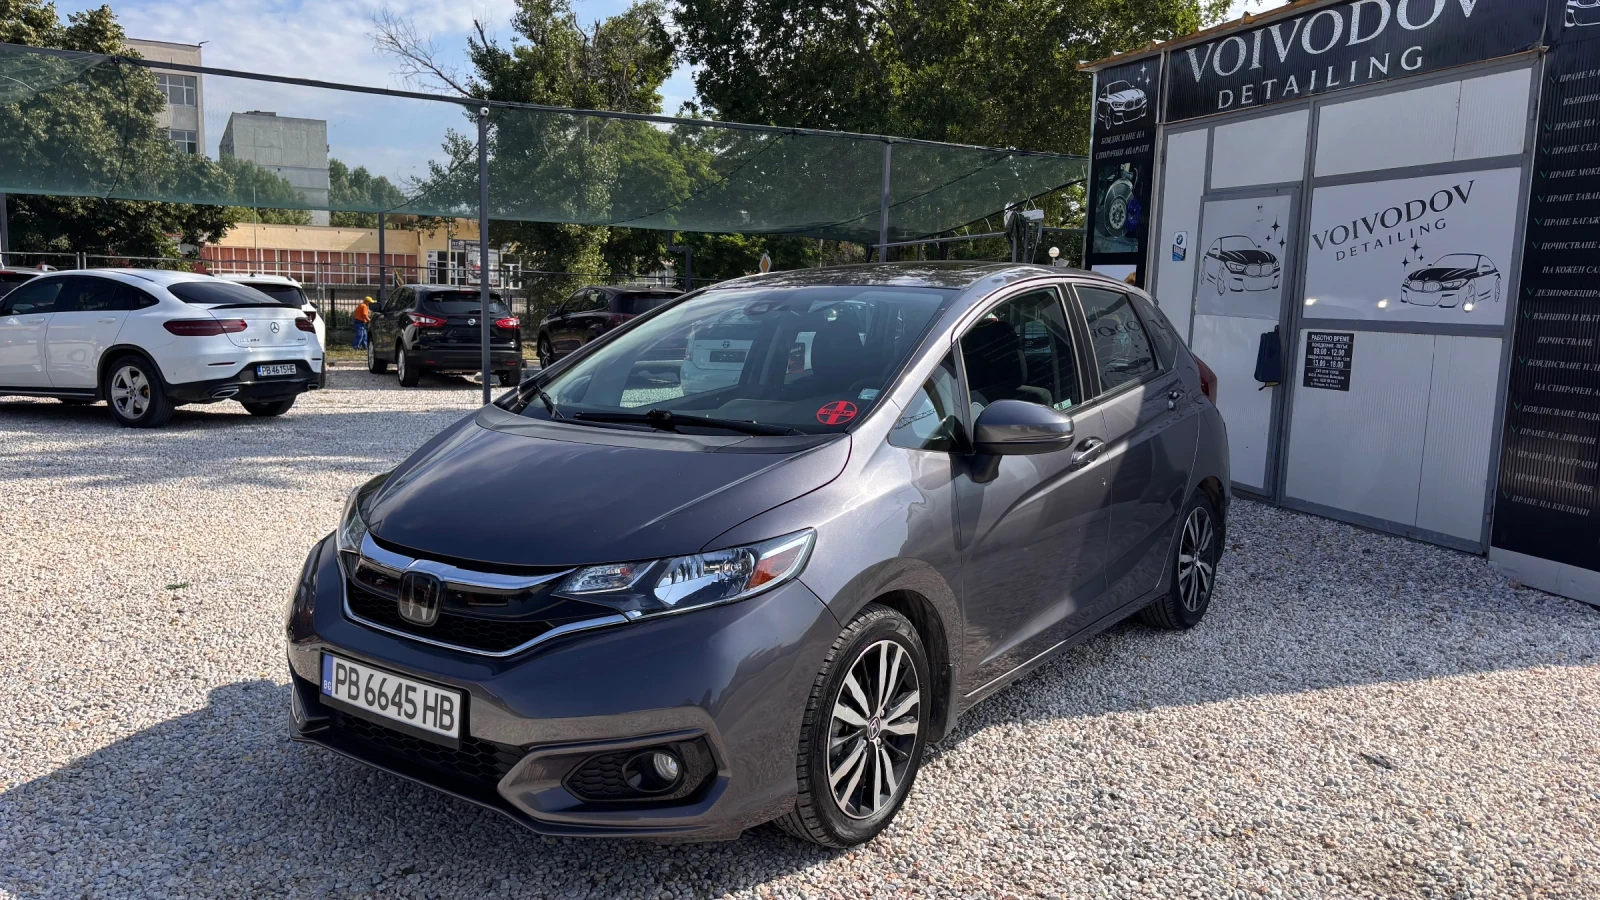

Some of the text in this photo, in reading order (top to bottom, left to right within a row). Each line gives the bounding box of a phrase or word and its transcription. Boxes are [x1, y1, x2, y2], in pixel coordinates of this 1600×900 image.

[1218, 45, 1423, 109] DETAILING
[1559, 71, 1587, 82] ПРАНЕ
[1554, 121, 1582, 131] ПРАНЕ
[1584, 118, 1595, 127] НА
[1552, 144, 1579, 155] ПРАНЕ
[1549, 170, 1578, 179] ПРАНЕ
[1546, 194, 1574, 202] ПРАНЕ
[1312, 179, 1475, 250] VOIVODOV
[1544, 218, 1571, 226] ПРАНЕ
[1336, 218, 1446, 261] DETAILING
[1541, 241, 1597, 250] ПОЧИСТВАНЕ
[1542, 266, 1553, 274] НА
[1555, 265, 1585, 274] КОЖЕН
[1571, 313, 1579, 321] И
[1537, 336, 1594, 346] ПОЧИСТВАНЕ
[1527, 358, 1581, 370] БОЯДИСВАНЕ
[1547, 384, 1592, 395] СПИРАЧЕН
[1522, 405, 1576, 418] БОЯДИСВАНЕ
[1520, 428, 1597, 445] ПРАНЕ НА ДИВАНИ
[1517, 450, 1544, 461] ПРАНЕ
[1544, 454, 1556, 463] НА
[1514, 473, 1540, 484] ПРАНЕ
[1555, 480, 1594, 493] СТОЛОВЕ
[1512, 495, 1590, 517] ПРАНЕ НА КИЛИМИ
[323, 680, 332, 690] BG
[335, 662, 455, 731] PB 6645 HB
